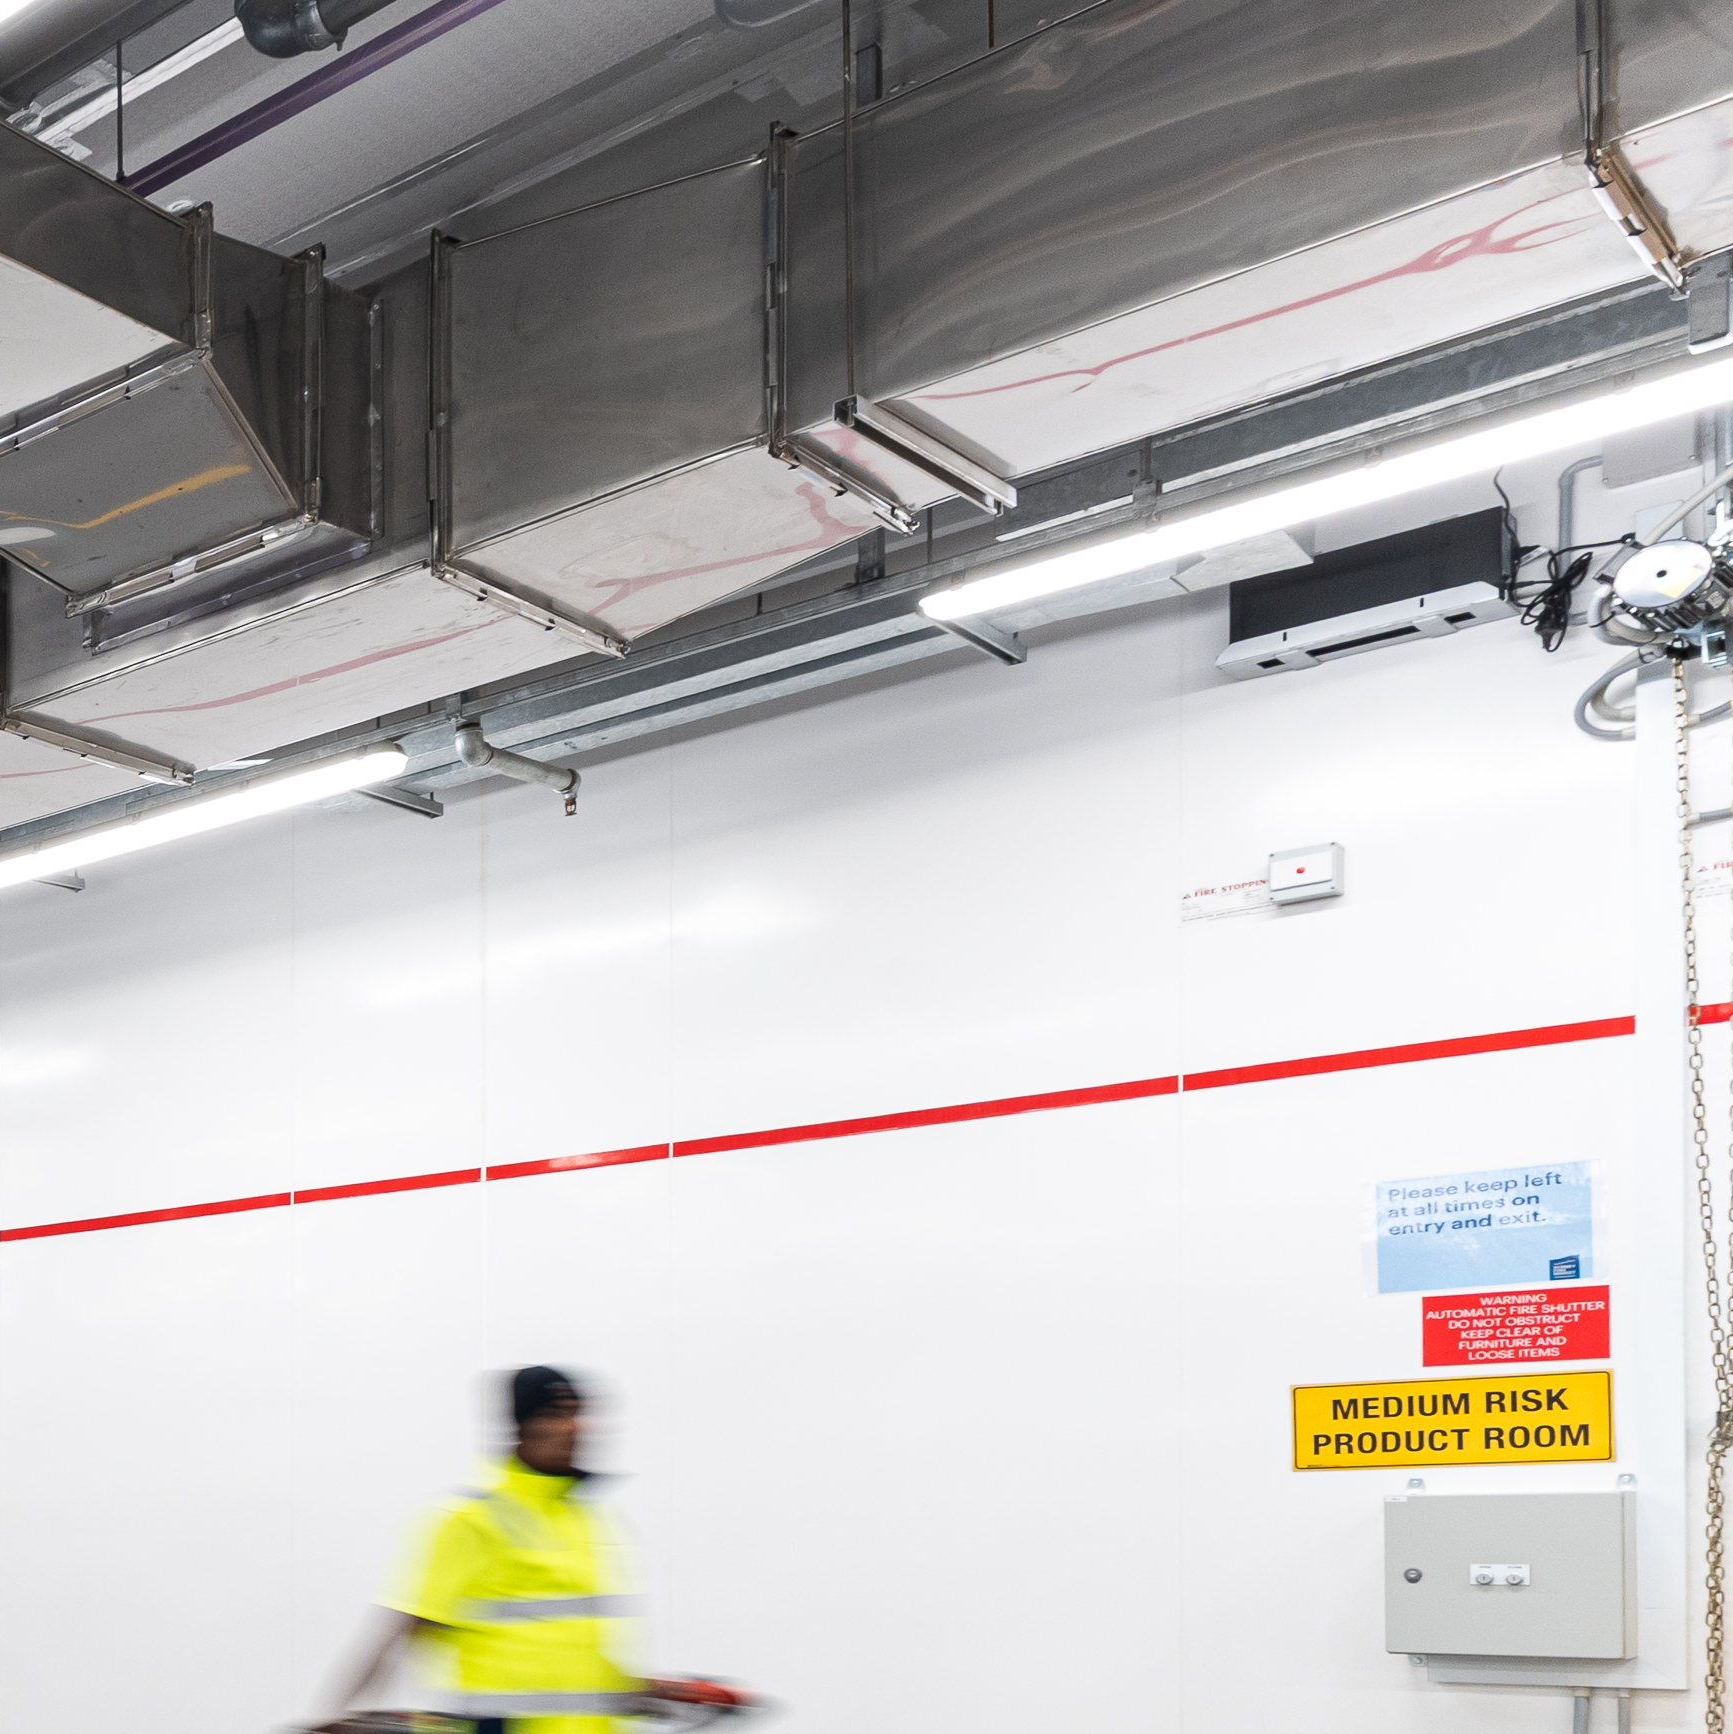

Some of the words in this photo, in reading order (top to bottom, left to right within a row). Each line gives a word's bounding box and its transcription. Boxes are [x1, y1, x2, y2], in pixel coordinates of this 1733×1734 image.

[1389, 1185, 1458, 1201] Please
[1464, 1179, 1518, 1193] keep
[1524, 1172, 1562, 1188] left
[1388, 1206, 1408, 1218] at
[1414, 1202, 1438, 1216] all
[1446, 1197, 1505, 1214] times
[1512, 1195, 1540, 1206] on
[1389, 1220, 1445, 1235] entry
[1452, 1214, 1492, 1230] and
[1498, 1211, 1546, 1226] exit.
[1480, 1293, 1548, 1306] WARNING
[1426, 1306, 1507, 1320] AUTOMATIC
[1510, 1304, 1538, 1315] FIRE
[1541, 1300, 1605, 1314] SHUTTER
[1448, 1319, 1470, 1330] DO
[1473, 1317, 1502, 1328] NOT
[1505, 1313, 1580, 1327] OBSTRUCT
[1461, 1329, 1493, 1339] KEEP
[1496, 1326, 1541, 1338] CLEAR
[1544, 1325, 1564, 1335] OF
[1458, 1338, 1534, 1350] FURNITURE
[1536, 1336, 1567, 1346] AND
[1468, 1349, 1515, 1361] LOOSE
[1519, 1347, 1560, 1358] ITEMS
[1332, 1393, 1470, 1420] MEDIUM
[1485, 1387, 1569, 1413] RISK
[1313, 1428, 1470, 1455] PRODUCT
[1484, 1424, 1590, 1449] ROOM
